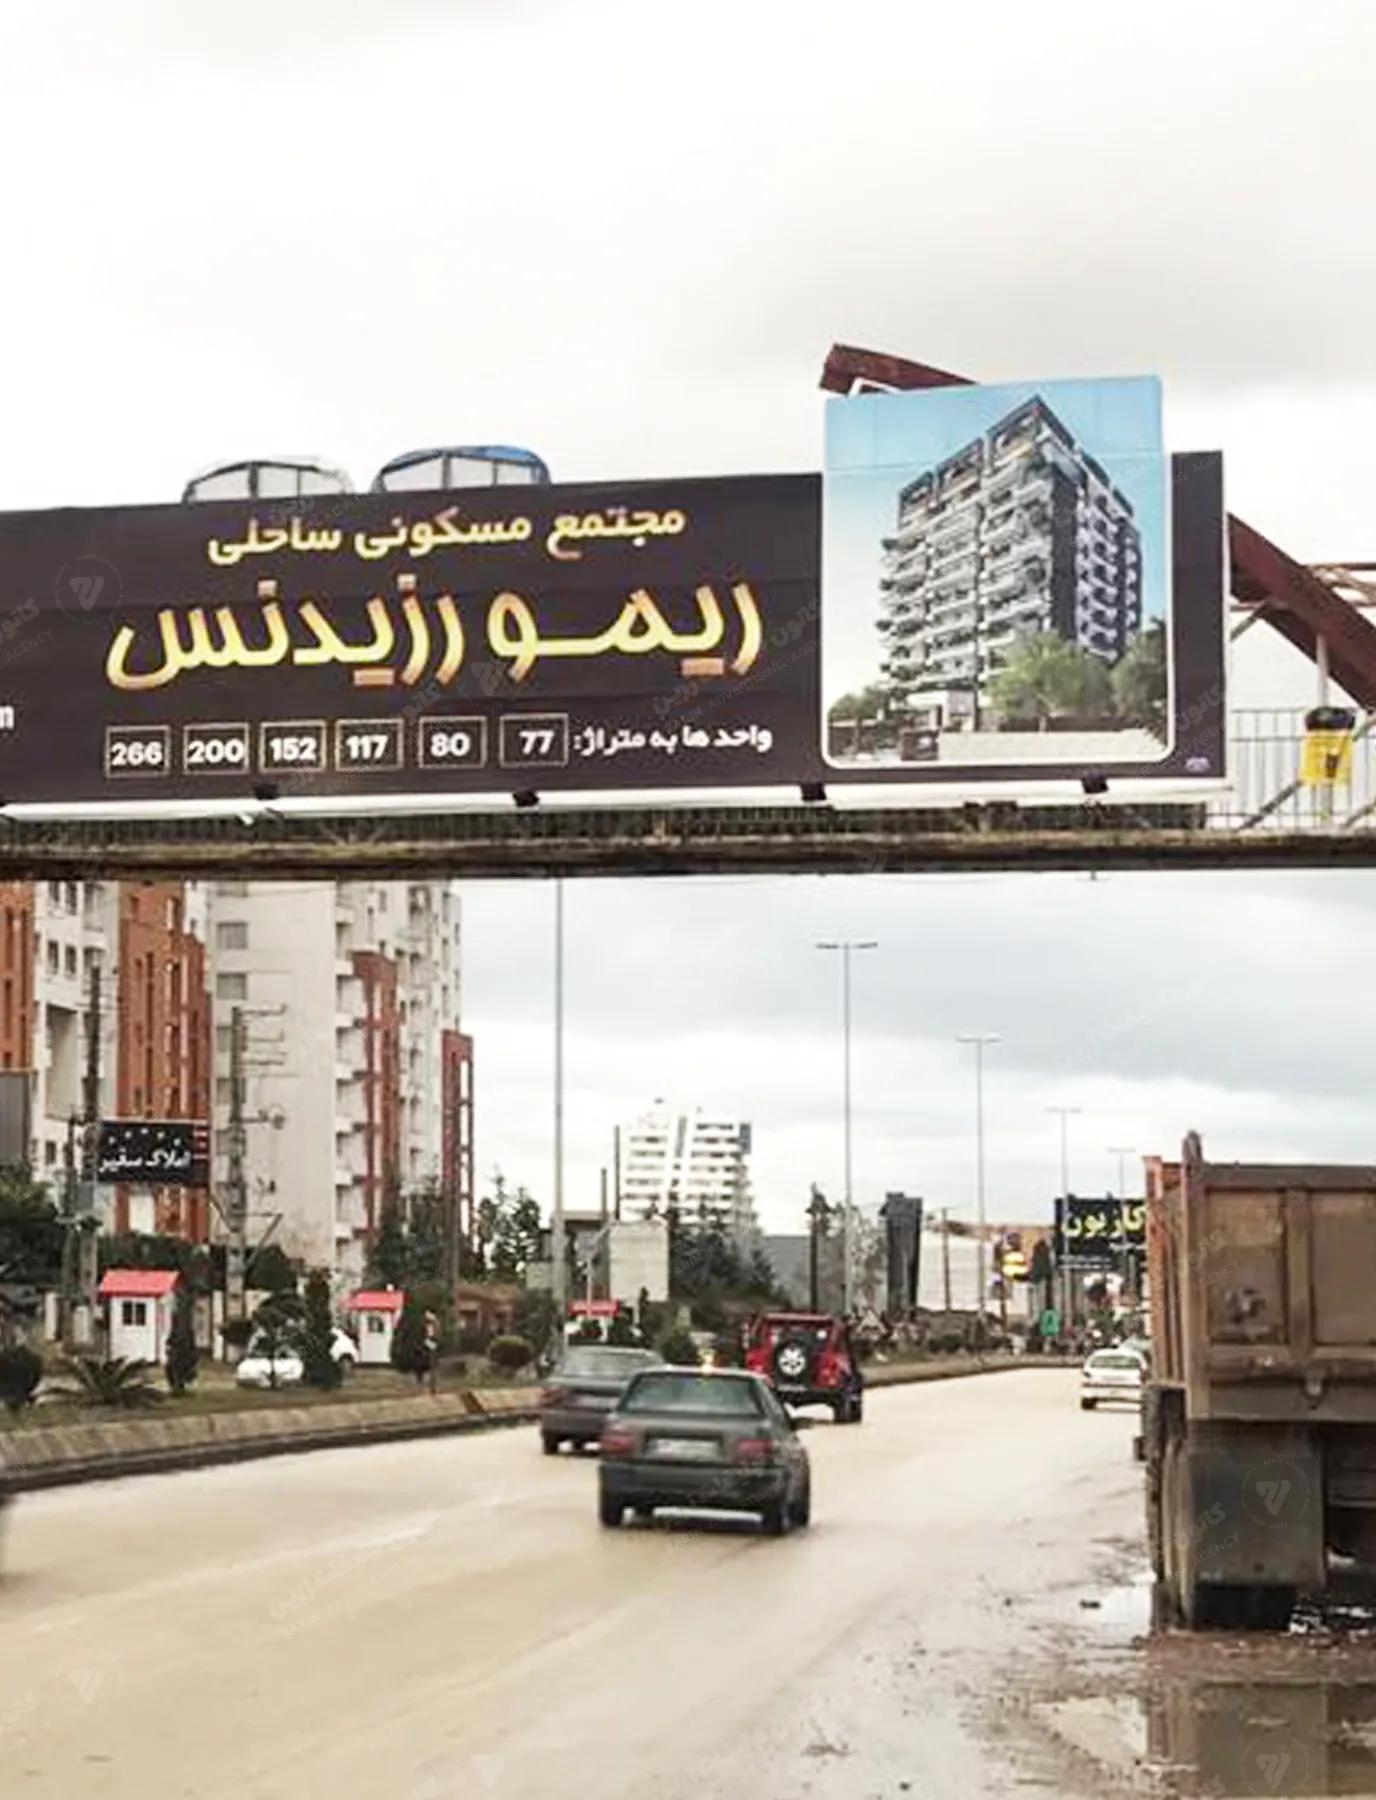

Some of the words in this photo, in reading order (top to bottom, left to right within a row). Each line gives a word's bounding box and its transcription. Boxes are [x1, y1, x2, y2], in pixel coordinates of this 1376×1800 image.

[209, 518, 341, 565] ساحلی
[355, 510, 531, 558] مسکونی
[547, 508, 685, 559] مجتمع
[107, 574, 464, 689] رزیدنس
[488, 584, 762, 680] ریمو
[347, 735, 388, 758] 117
[431, 733, 469, 756] 80
[520, 731, 553, 753] 77
[650, 731, 677, 753] به
[683, 726, 710, 747] ها
[714, 725, 772, 752] واحد
[112, 742, 163, 766] 266
[187, 740, 244, 764] 200
[270, 737, 316, 761] 152
[146, 1149, 191, 1169] املاک
